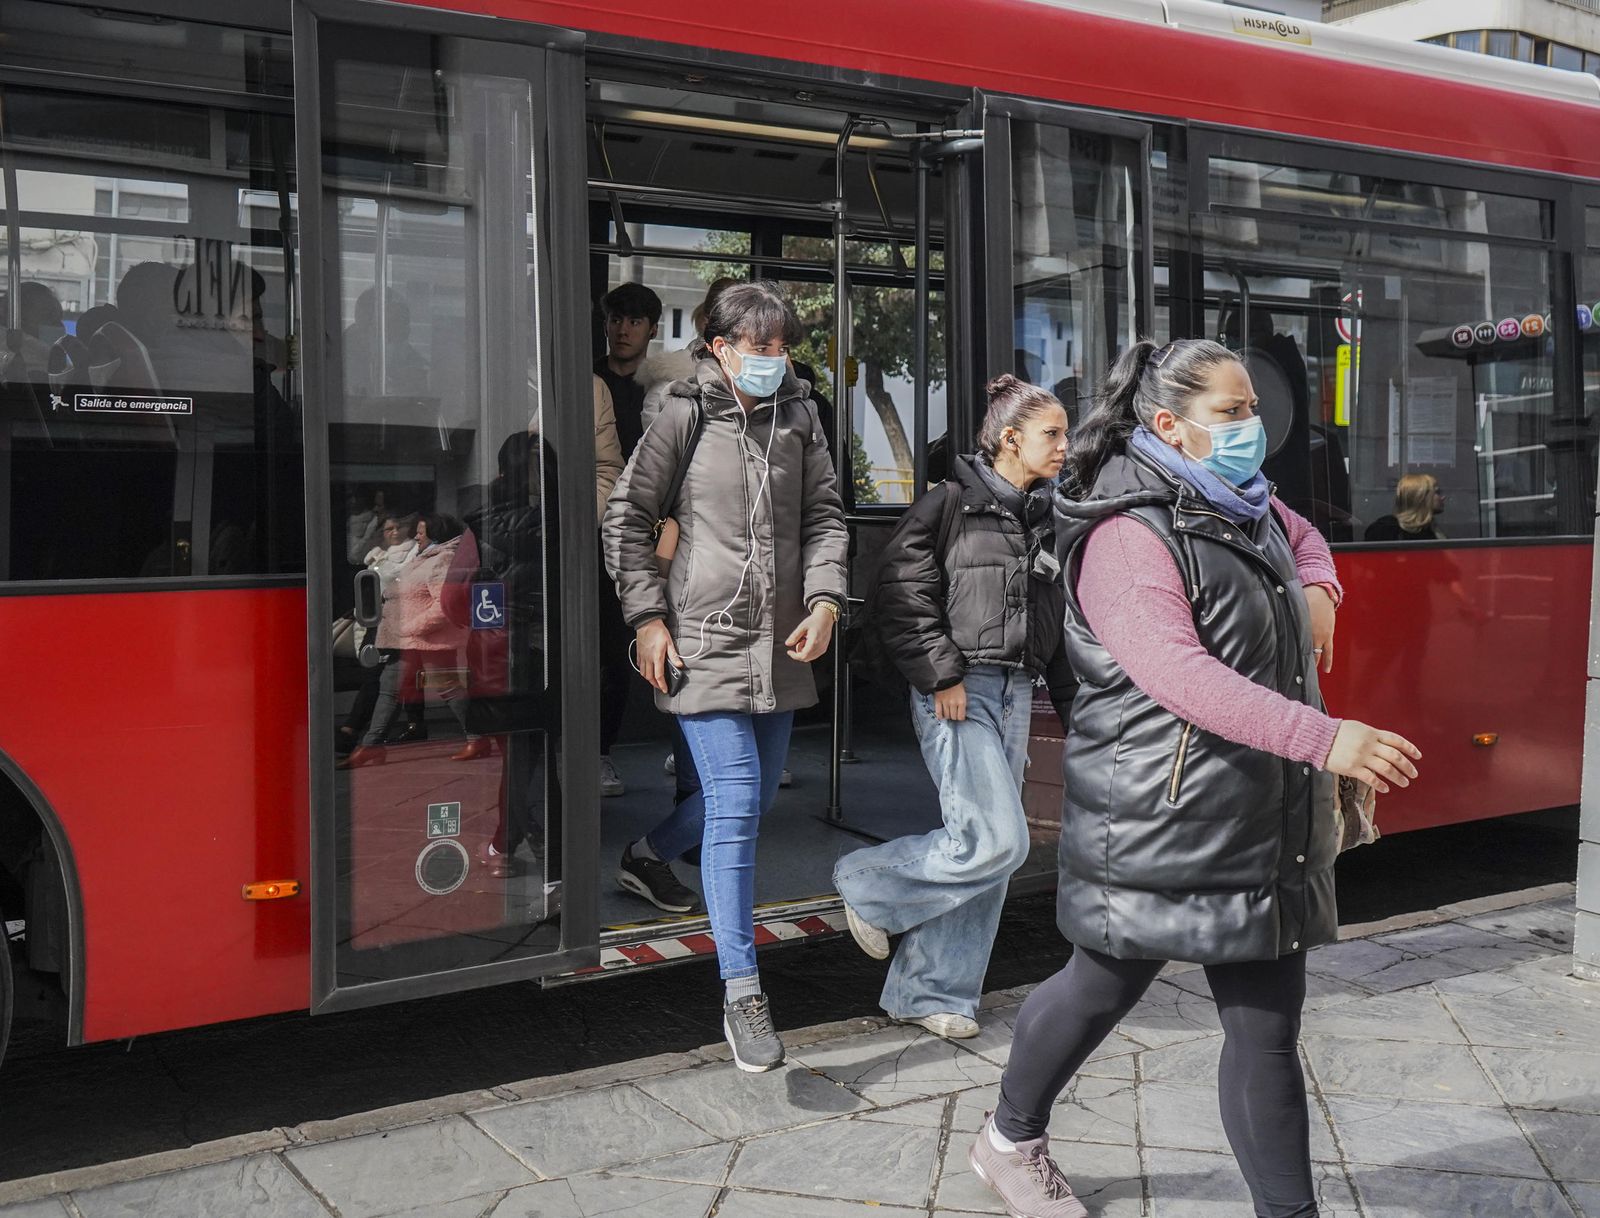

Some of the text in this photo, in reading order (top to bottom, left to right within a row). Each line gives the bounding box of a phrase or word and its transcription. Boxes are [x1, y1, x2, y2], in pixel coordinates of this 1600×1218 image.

[1243, 17, 1300, 37] HISPACOLD
[79, 398, 188, 412] Salida de emergencia
